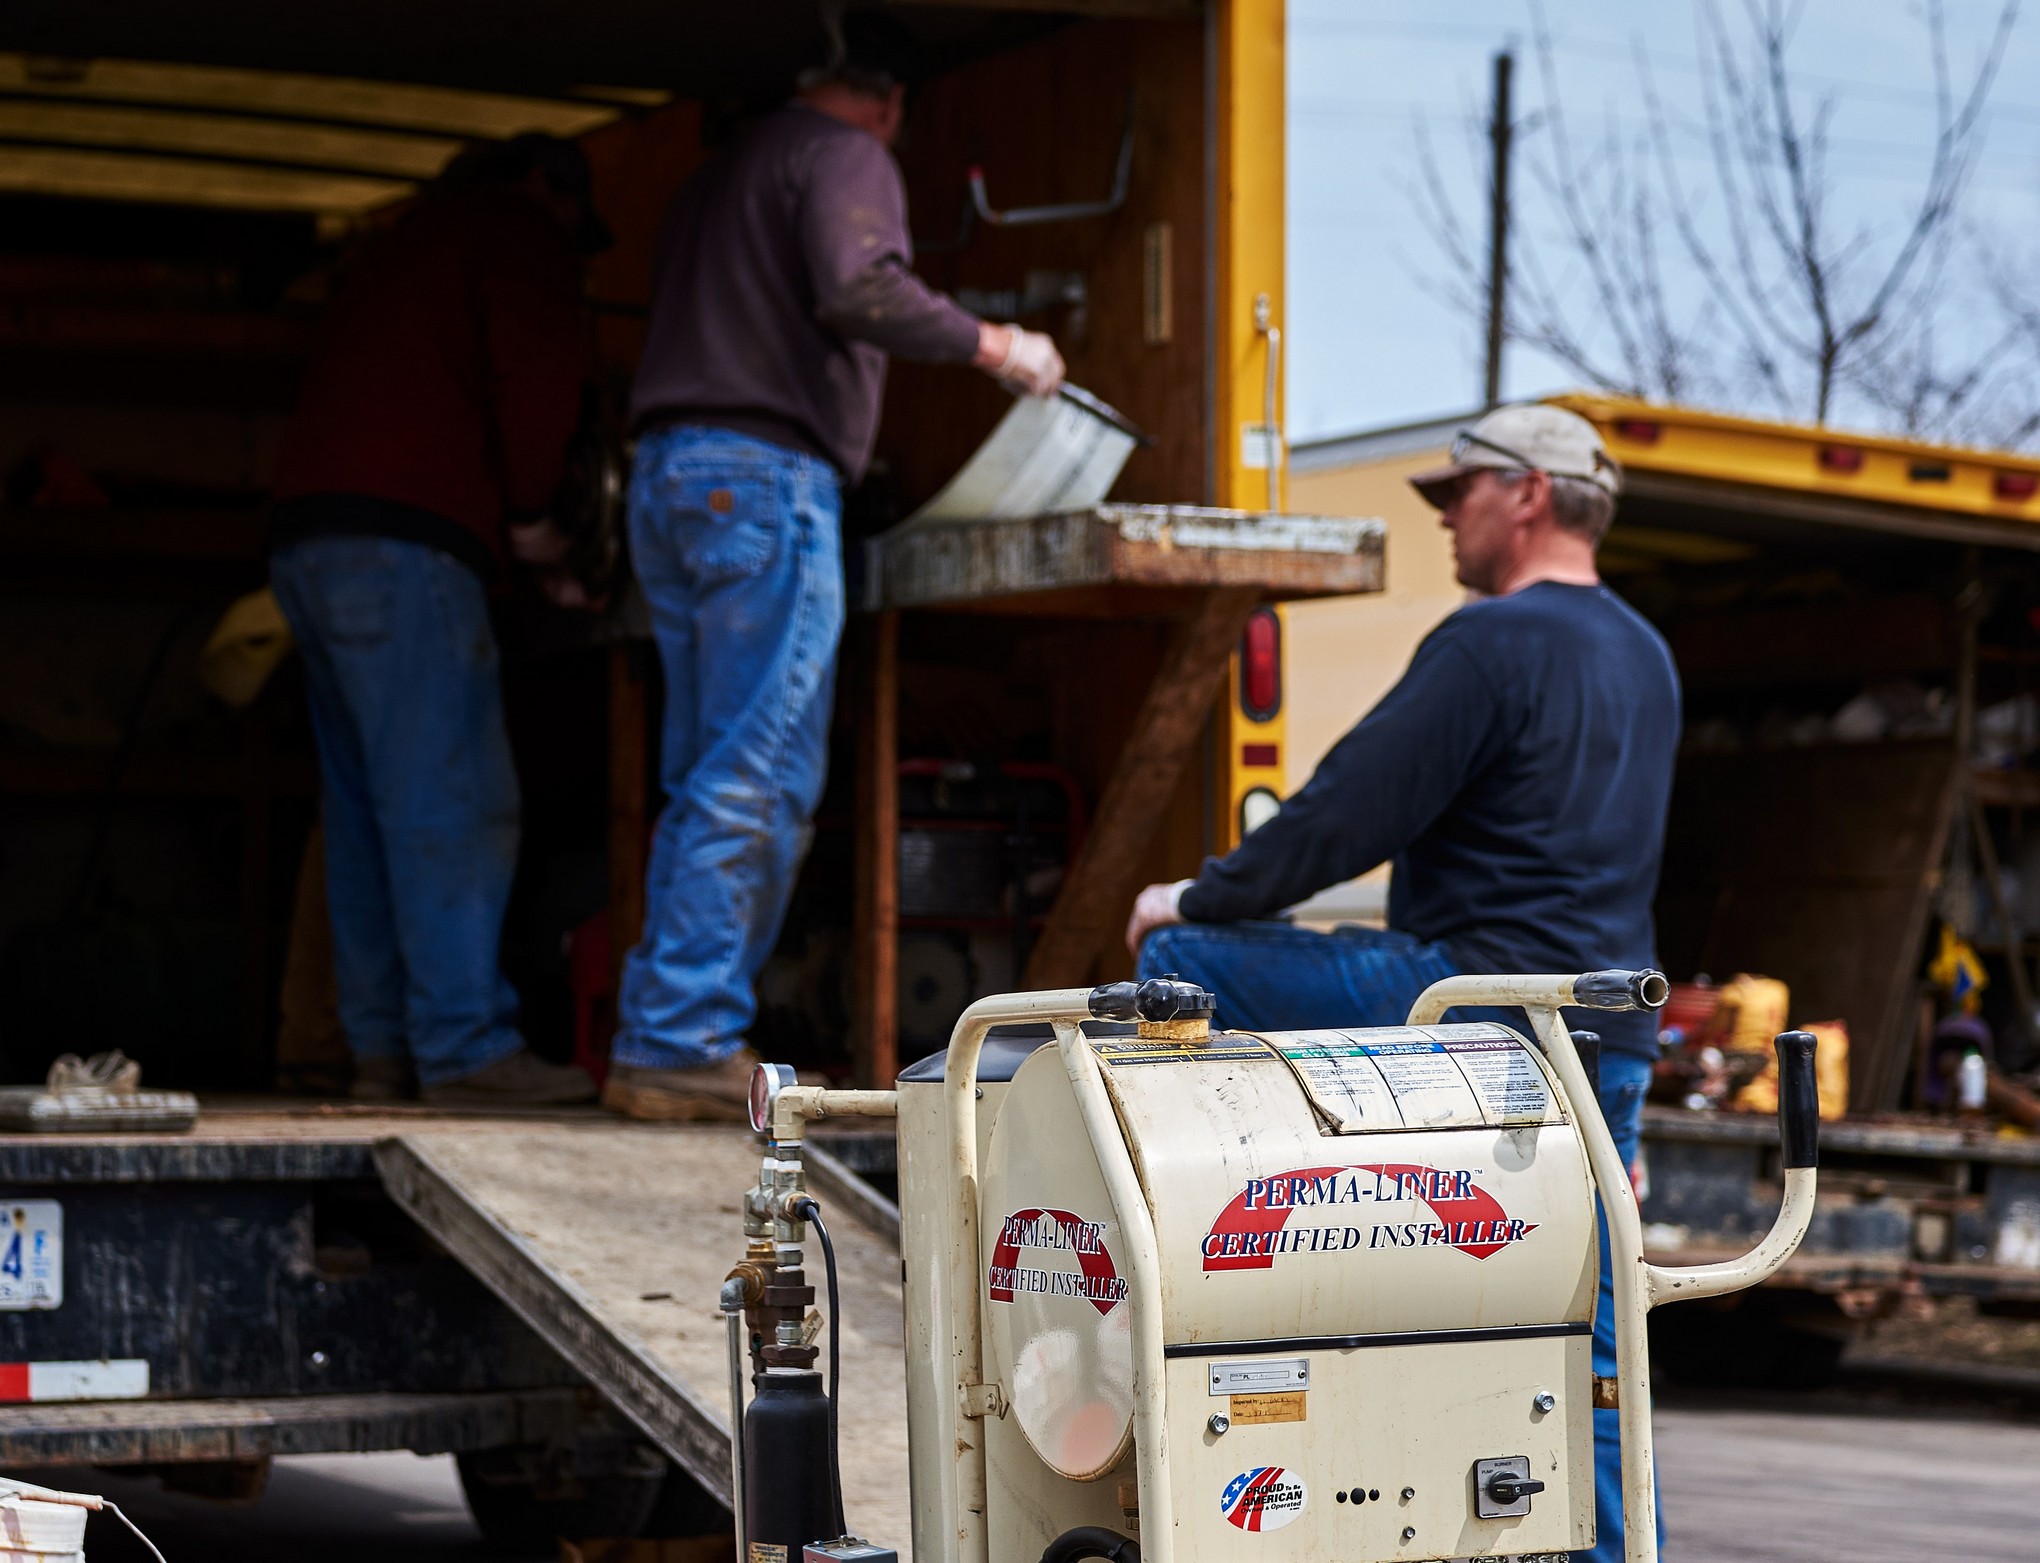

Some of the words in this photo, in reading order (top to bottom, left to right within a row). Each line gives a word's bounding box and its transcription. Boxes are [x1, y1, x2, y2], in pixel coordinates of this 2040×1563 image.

[1444, 1042, 1521, 1050] PRECAUTIONS
[1244, 1170, 1477, 1211] PERMA-LINER
[1003, 1216, 1101, 1254] PERMA-LINER
[1201, 1227, 1361, 1258] CERTIFIED
[1369, 1220, 1525, 1249] INSTALLER
[989, 1266, 1048, 1292] CERTIFIED
[1051, 1273, 1126, 1300] INSTALLER
[1242, 1491, 1303, 1507] AMERICAN
[1245, 1483, 1284, 1496] PROUD
[1271, 1500, 1301, 1510] Operated
